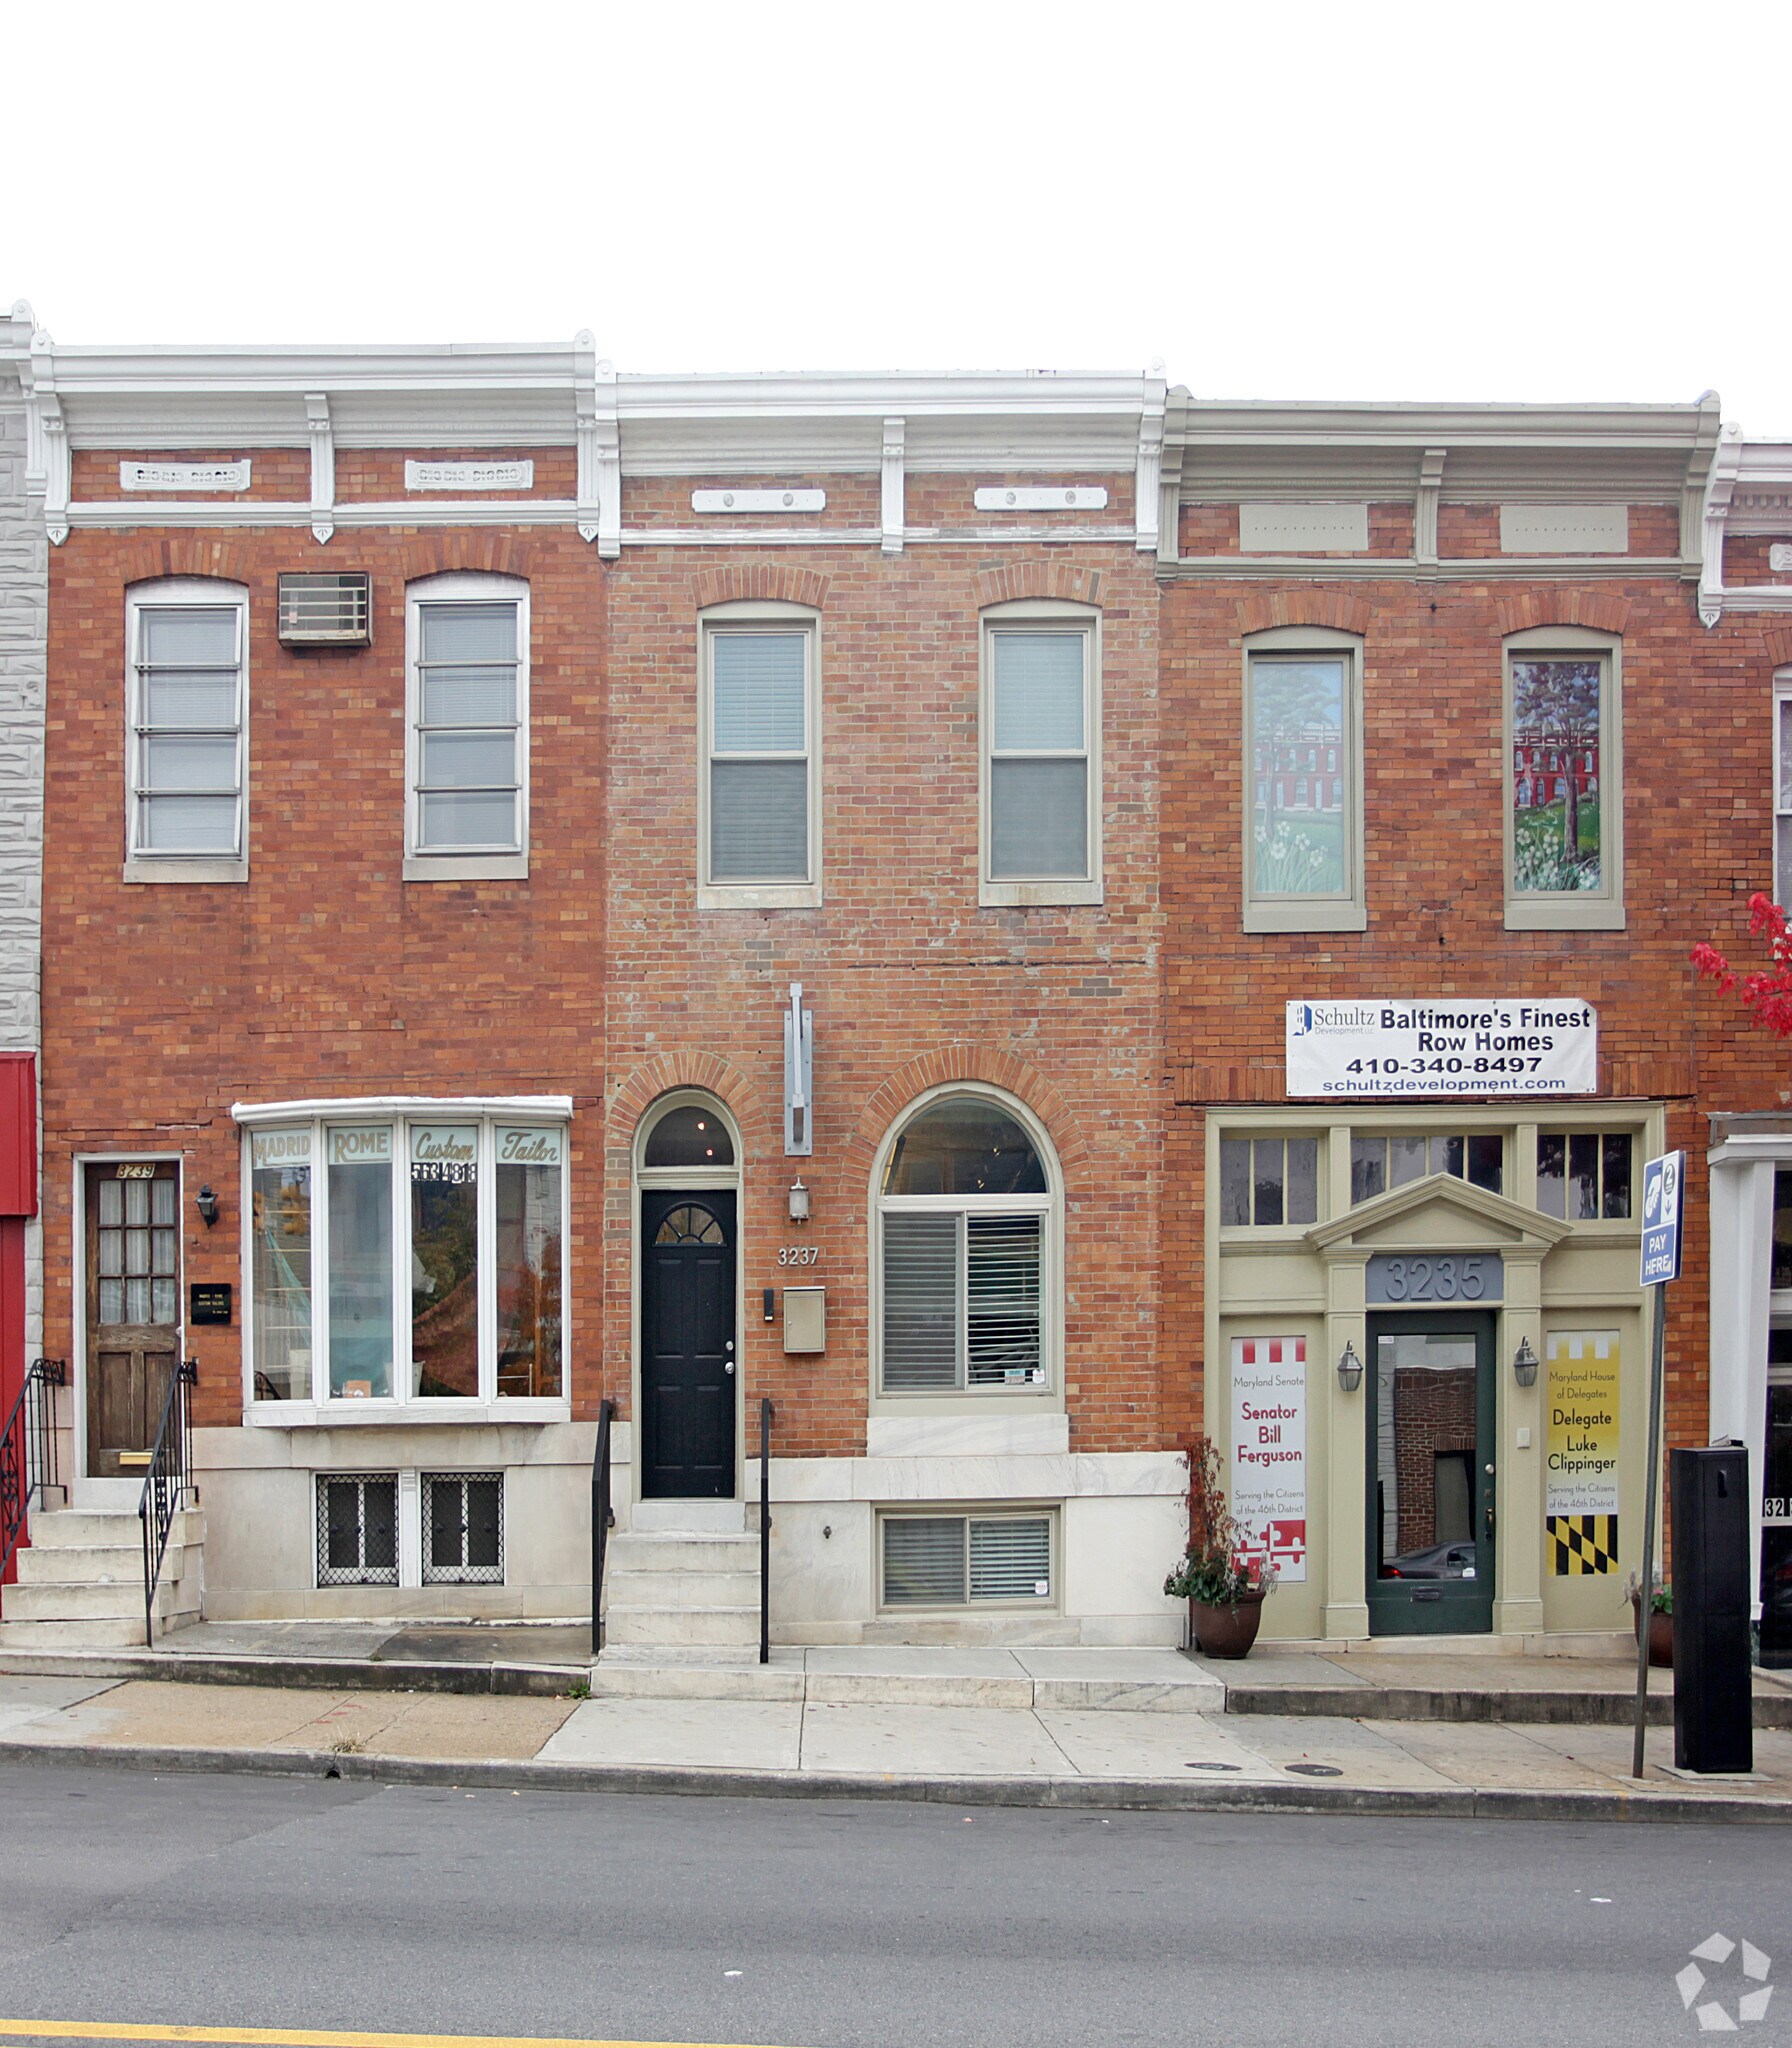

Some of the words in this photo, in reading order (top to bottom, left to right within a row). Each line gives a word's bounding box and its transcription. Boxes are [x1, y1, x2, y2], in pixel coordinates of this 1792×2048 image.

[1314, 1007, 1375, 1026] Schultz
[1380, 1008, 1512, 1029] Baltimore's
[1520, 1008, 1590, 1028] Finest
[1315, 1026, 1363, 1036] Development
[1418, 1032, 1466, 1051] Row
[1475, 1032, 1554, 1051] Homes
[1346, 1057, 1543, 1074] 410-340-8497
[1322, 1077, 1566, 1093] schultzdevelopment.com
[252, 1135, 311, 1167] MADRID
[334, 1132, 388, 1162] ROME
[415, 1132, 474, 1160] Custom
[501, 1132, 558, 1161] Tailor
[1648, 1233, 1667, 1254] PAY
[778, 1247, 819, 1266] 3237
[1386, 1257, 1485, 1300] 3235
[1233, 1375, 1273, 1389] Maryland
[1275, 1374, 1304, 1386] Senate
[1549, 1370, 1588, 1384] Maryland
[1590, 1370, 1616, 1381] House
[1556, 1387, 1565, 1399] of
[1567, 1387, 1608, 1401] Delegates
[1241, 1401, 1297, 1420] Senator
[1553, 1408, 1612, 1429] Delegate
[1258, 1425, 1281, 1444] Bill
[1567, 1434, 1598, 1452] Luke
[1238, 1445, 1302, 1467] Ferguson
[1548, 1453, 1616, 1474] Clippinger
[1235, 1490, 1262, 1501] Serving
[1263, 1489, 1274, 1499] the
[1276, 1488, 1304, 1498] Citizens
[1548, 1484, 1574, 1496] Serving
[1575, 1483, 1586, 1493] the
[1588, 1482, 1615, 1493] Citizens
[1236, 1504, 1243, 1515] of
[1245, 1504, 1256, 1515] the
[1258, 1504, 1275, 1514] 46th
[1278, 1503, 1303, 1513] District
[1549, 1498, 1556, 1509] of
[1557, 1498, 1568, 1508] the
[1570, 1498, 1588, 1508] 46th
[1589, 1498, 1614, 1508] District
